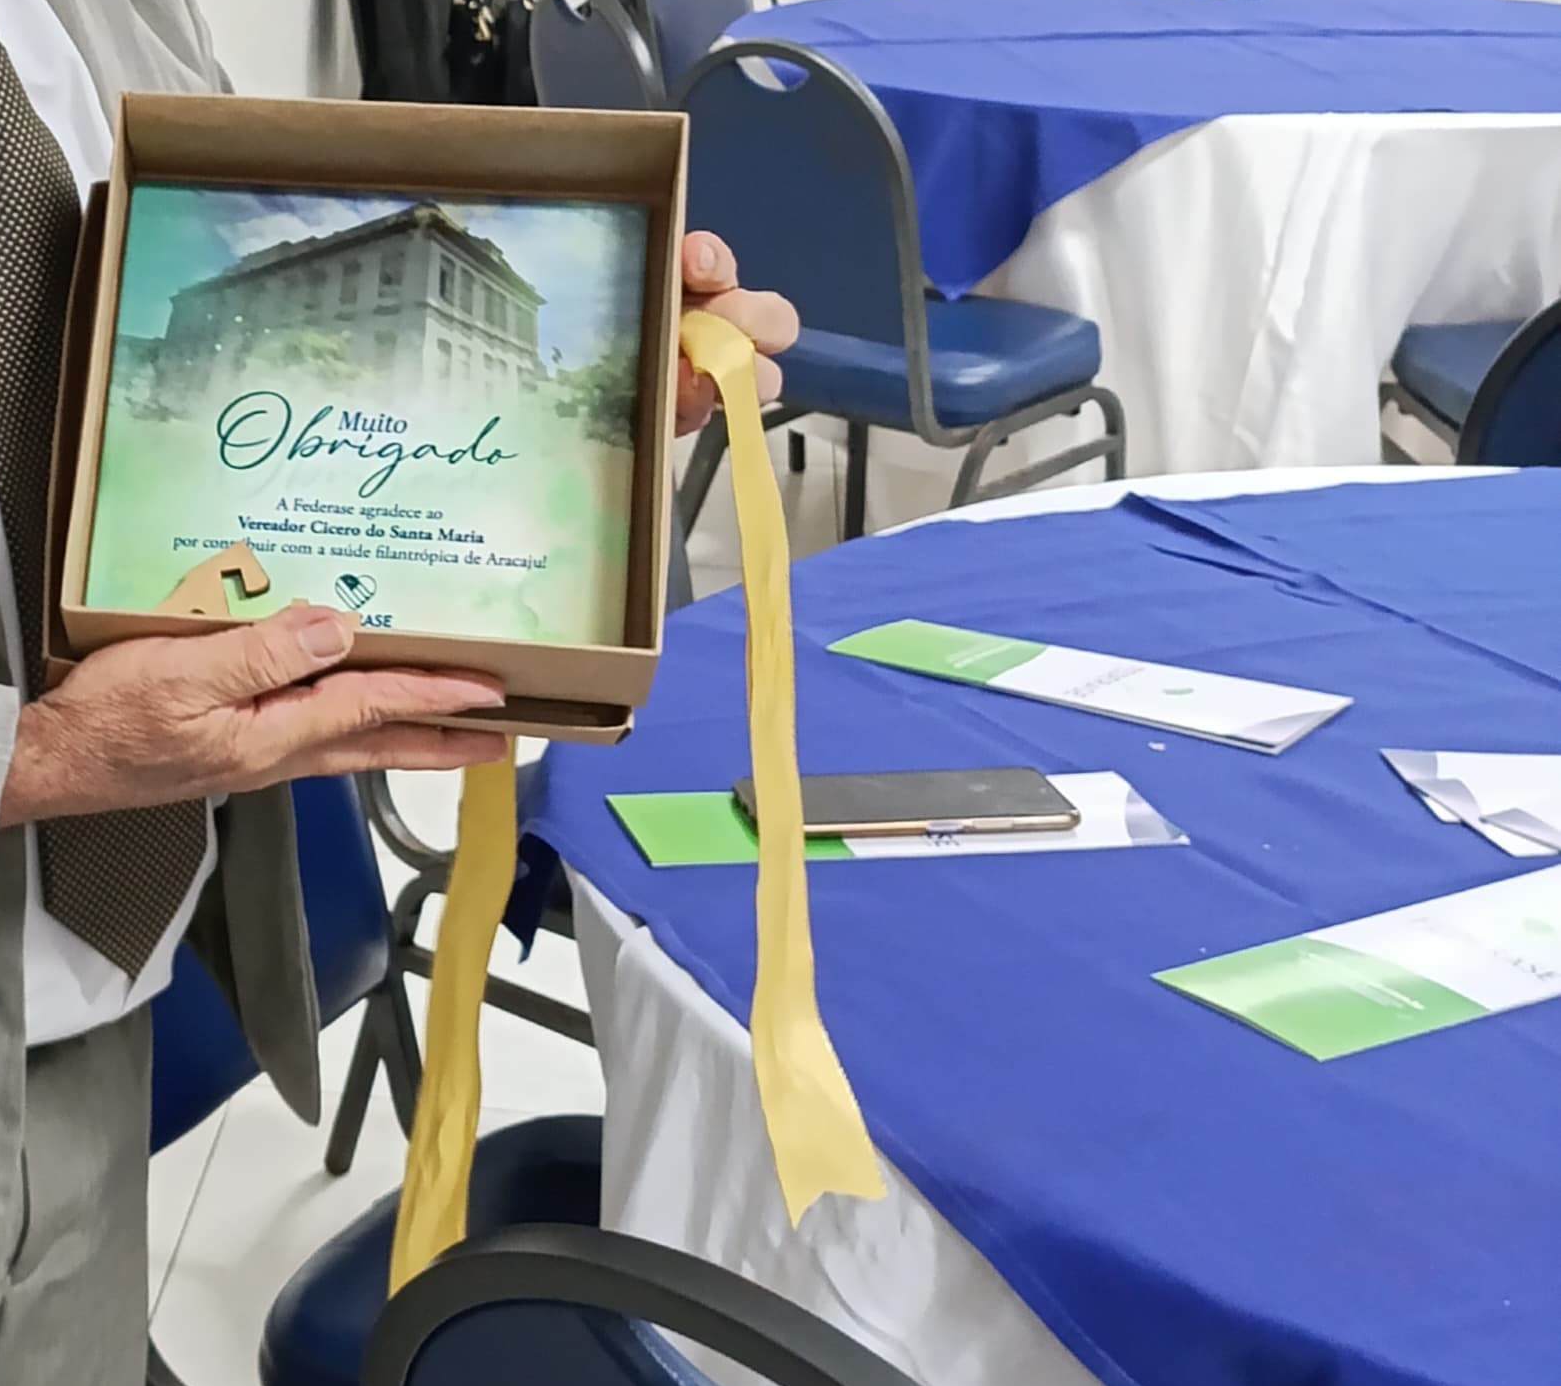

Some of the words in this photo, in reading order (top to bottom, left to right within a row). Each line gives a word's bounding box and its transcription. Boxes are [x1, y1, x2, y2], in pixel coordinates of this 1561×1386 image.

[337, 410, 408, 434] Muito
[216, 391, 519, 498] Obrigado
[276, 497, 288, 511] A
[293, 498, 354, 515] Federase
[359, 504, 422, 520] agradece
[426, 510, 443, 520] ao
[238, 515, 306, 533] Vereador
[365, 524, 385, 537] do
[389, 525, 432, 541] Santa
[438, 528, 484, 544] Maria
[173, 536, 198, 551] por
[281, 543, 312, 555] com
[317, 546, 325, 555] a
[375, 545, 459, 566] filantrópica
[464, 551, 482, 565] de
[486, 553, 547, 570] Aracaju!
